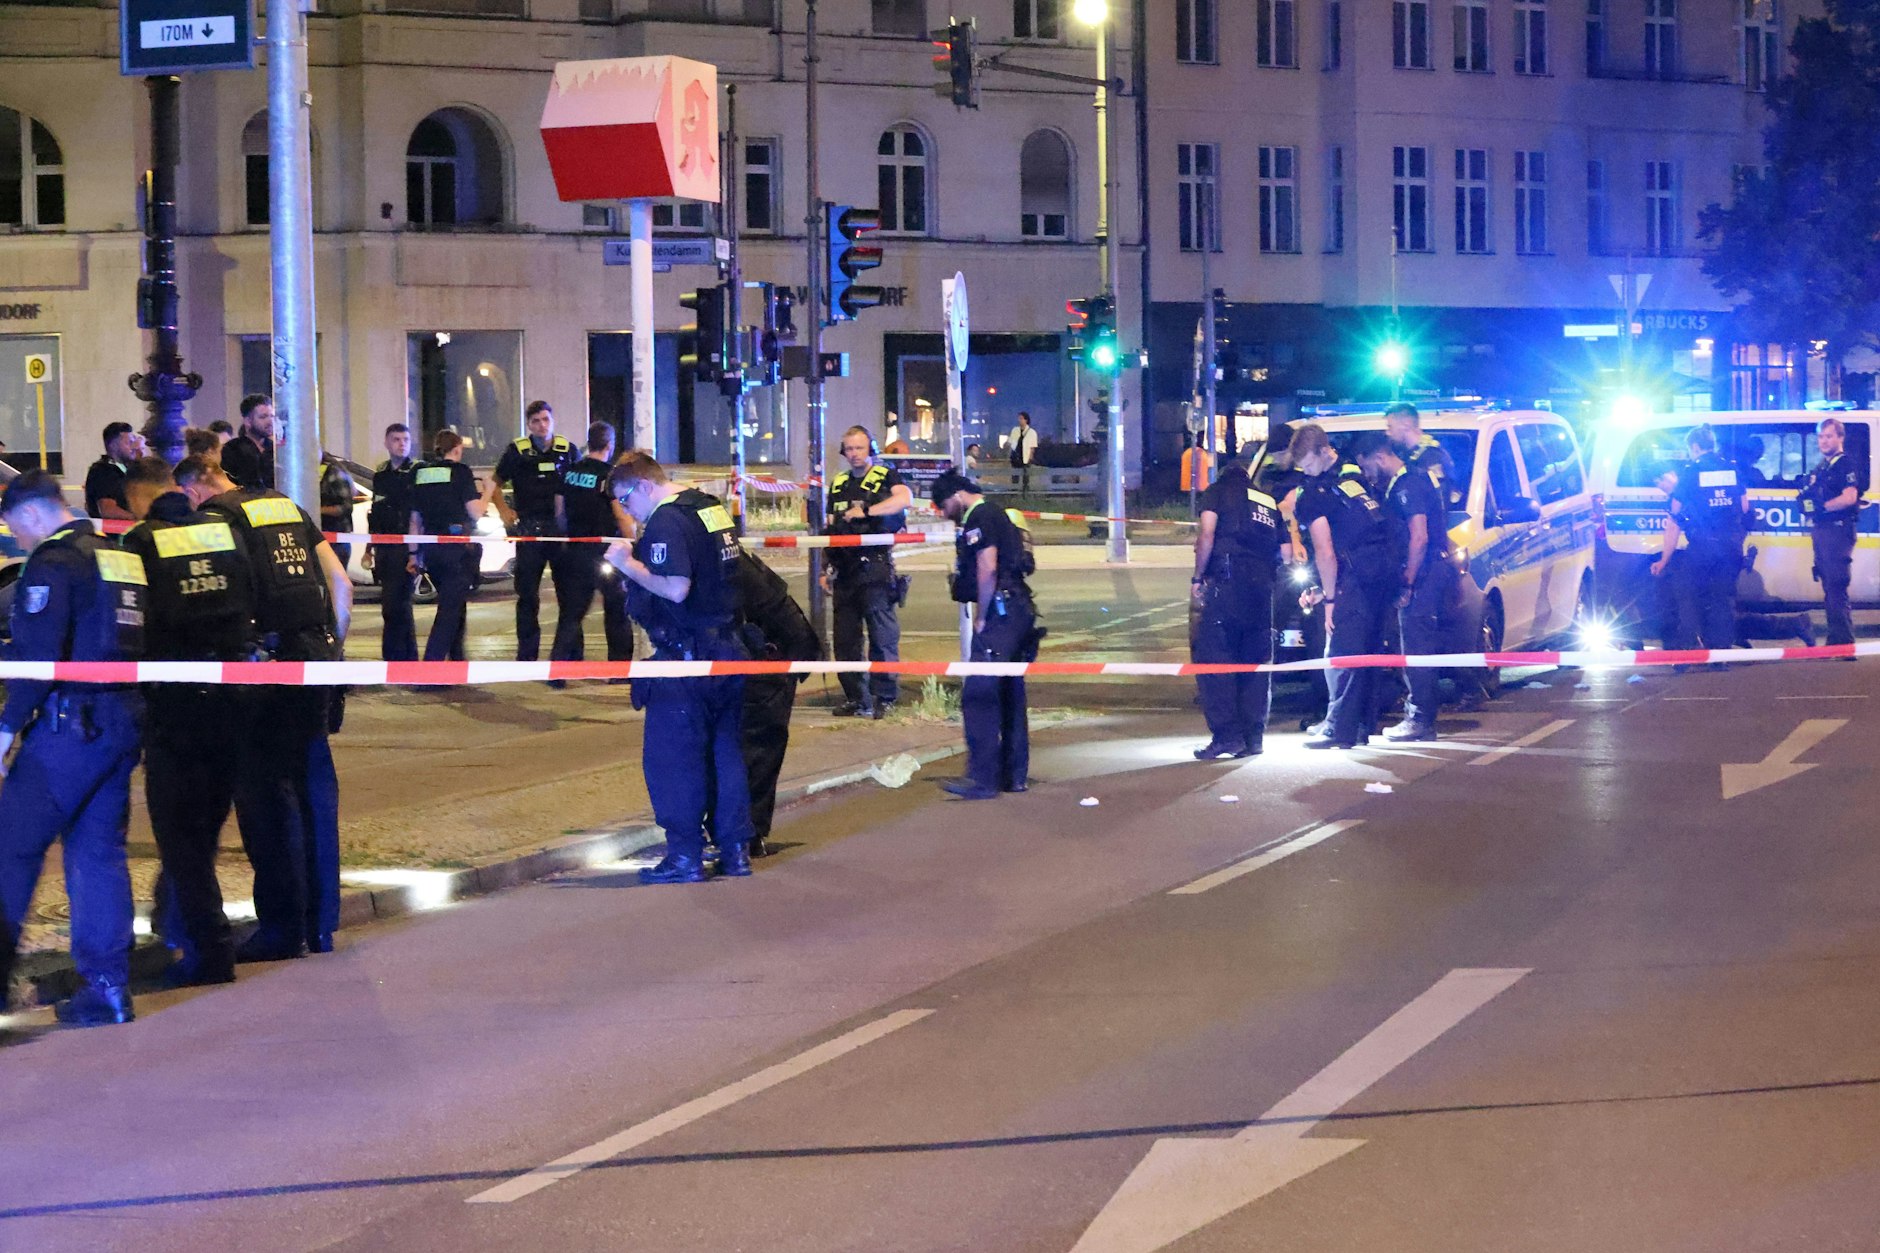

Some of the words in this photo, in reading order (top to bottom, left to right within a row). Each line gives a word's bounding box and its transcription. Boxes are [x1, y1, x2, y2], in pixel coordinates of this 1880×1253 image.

[616, 244, 703, 256] Kutendamm
[564, 471, 597, 489] POLIZEI
[1714, 489, 1726, 498] BE
[279, 532, 295, 547] BE
[273, 548, 307, 564] 12310
[189, 559, 214, 576] BE
